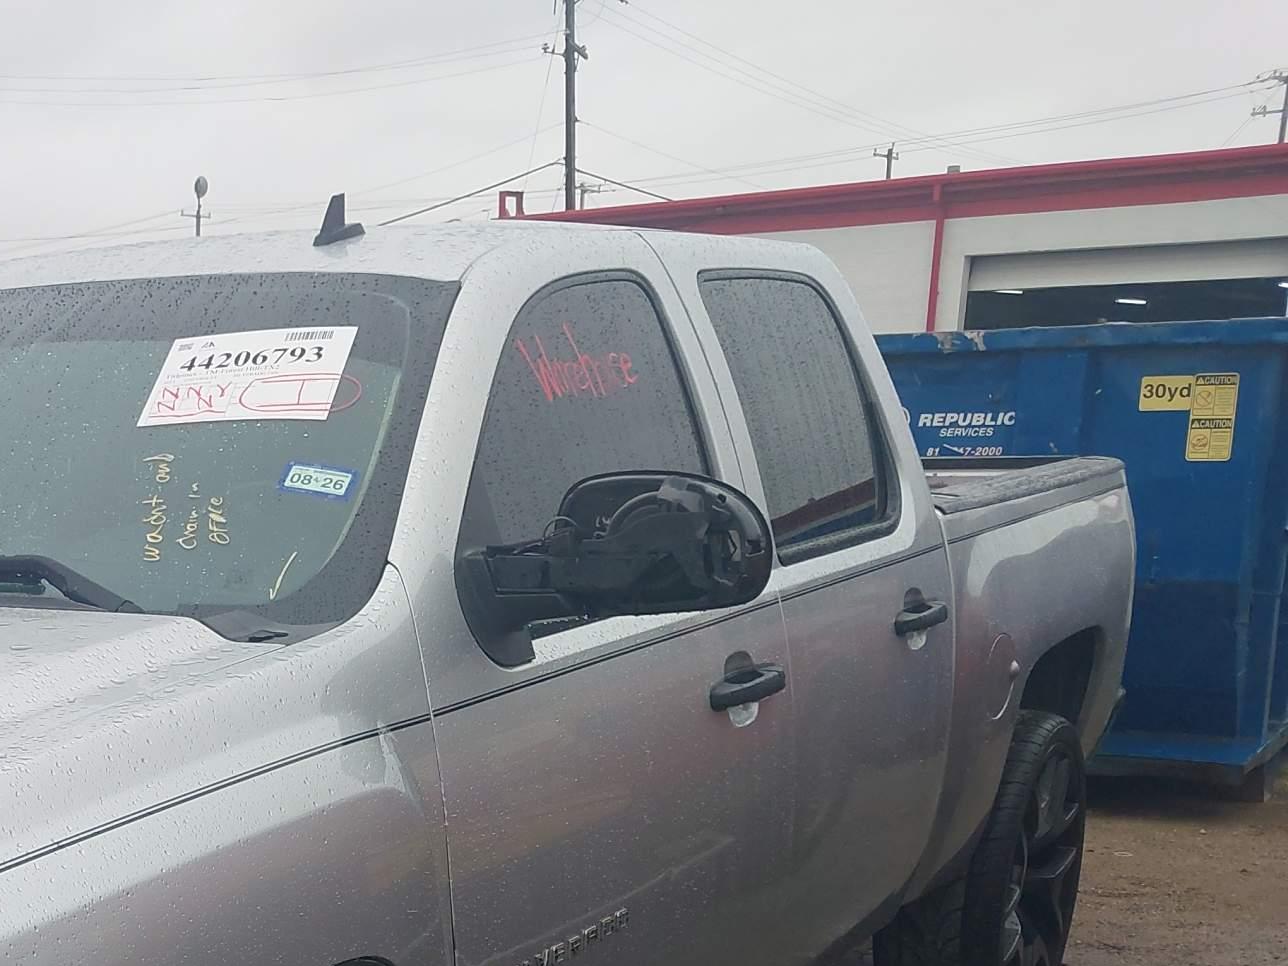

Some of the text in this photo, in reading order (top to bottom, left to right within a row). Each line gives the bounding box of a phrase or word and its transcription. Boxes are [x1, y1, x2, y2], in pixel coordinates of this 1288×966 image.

[180, 346, 325, 372] 44206793
[1143, 383, 1192, 402] 30yd
[918, 411, 1016, 427] REPUBLIC
[939, 427, 994, 437] SERVICES
